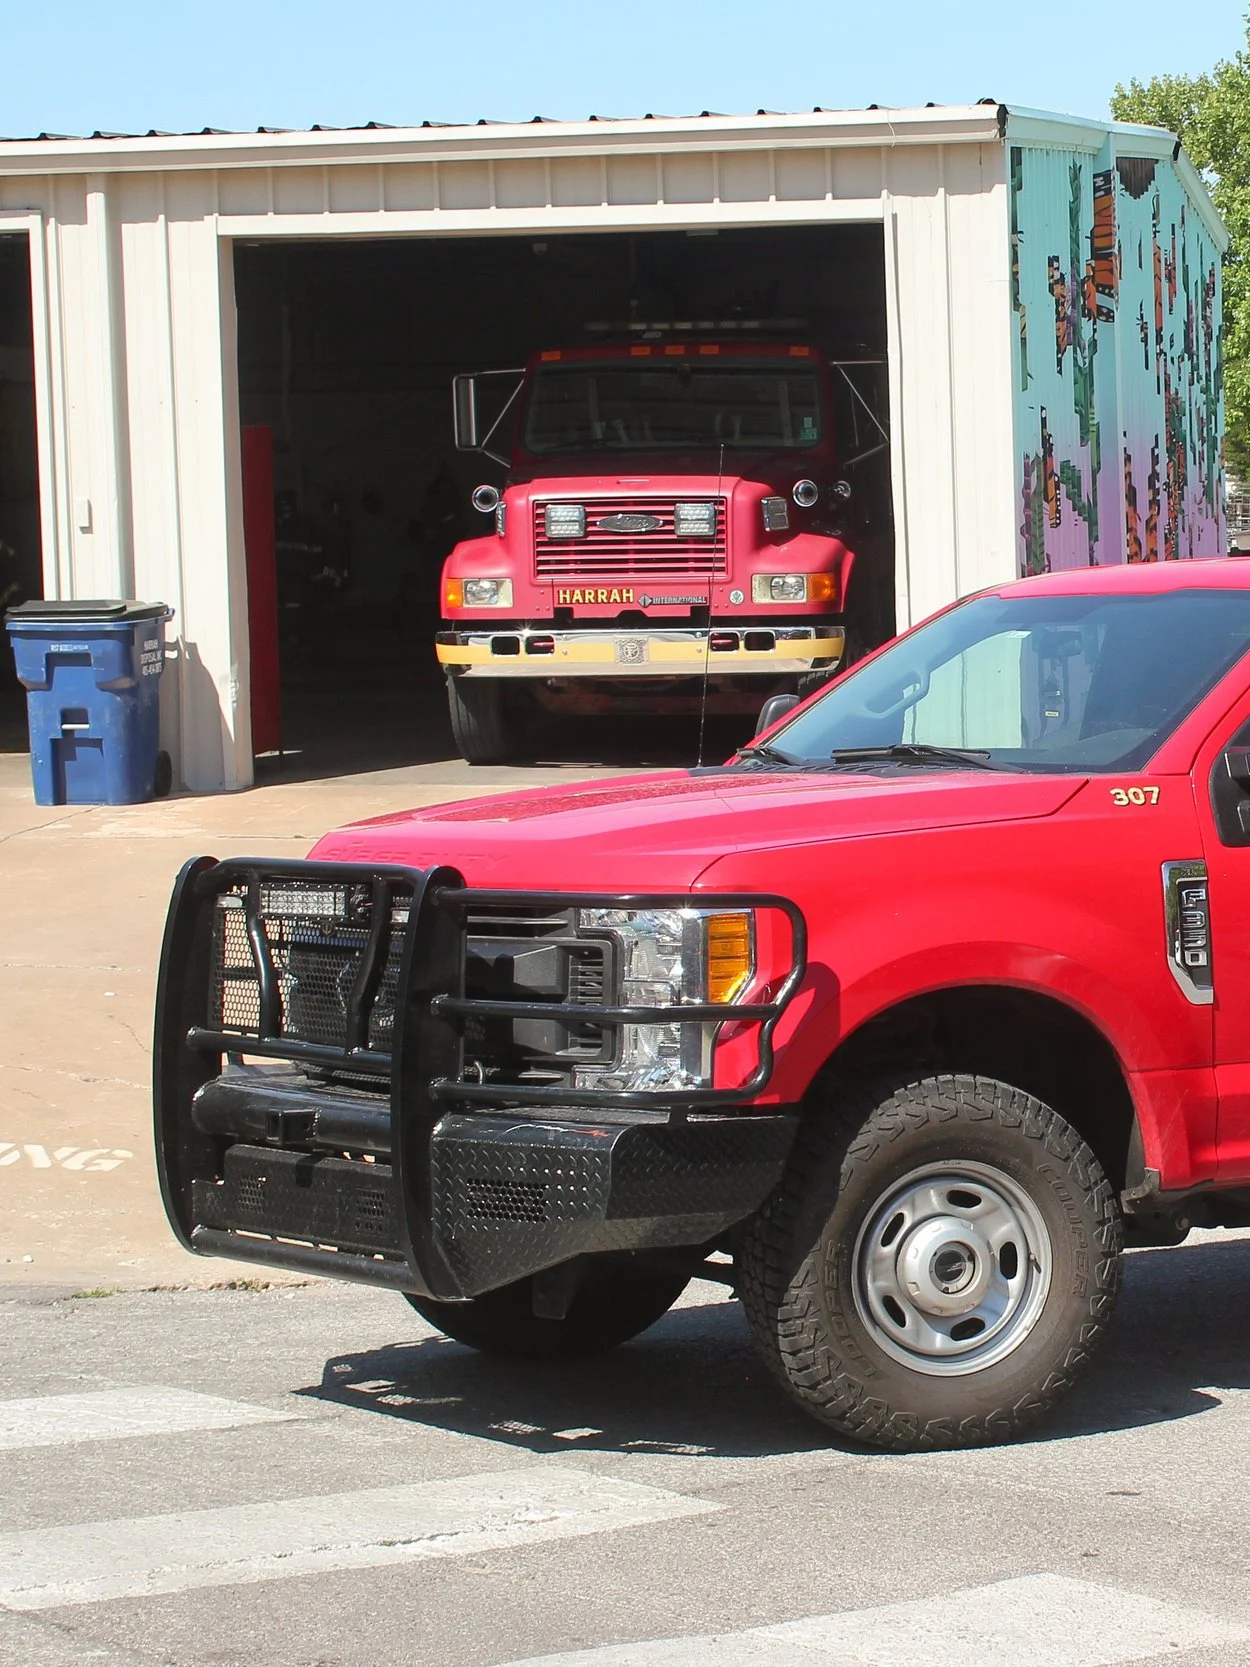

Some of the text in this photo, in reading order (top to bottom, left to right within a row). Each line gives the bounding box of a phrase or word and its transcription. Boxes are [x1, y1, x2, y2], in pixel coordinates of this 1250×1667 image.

[558, 588, 635, 605] HARRAH
[652, 596, 706, 604] INTERNATIONAL
[1109, 786, 1160, 806] 307
[1036, 1163, 1090, 1299] COOPER
